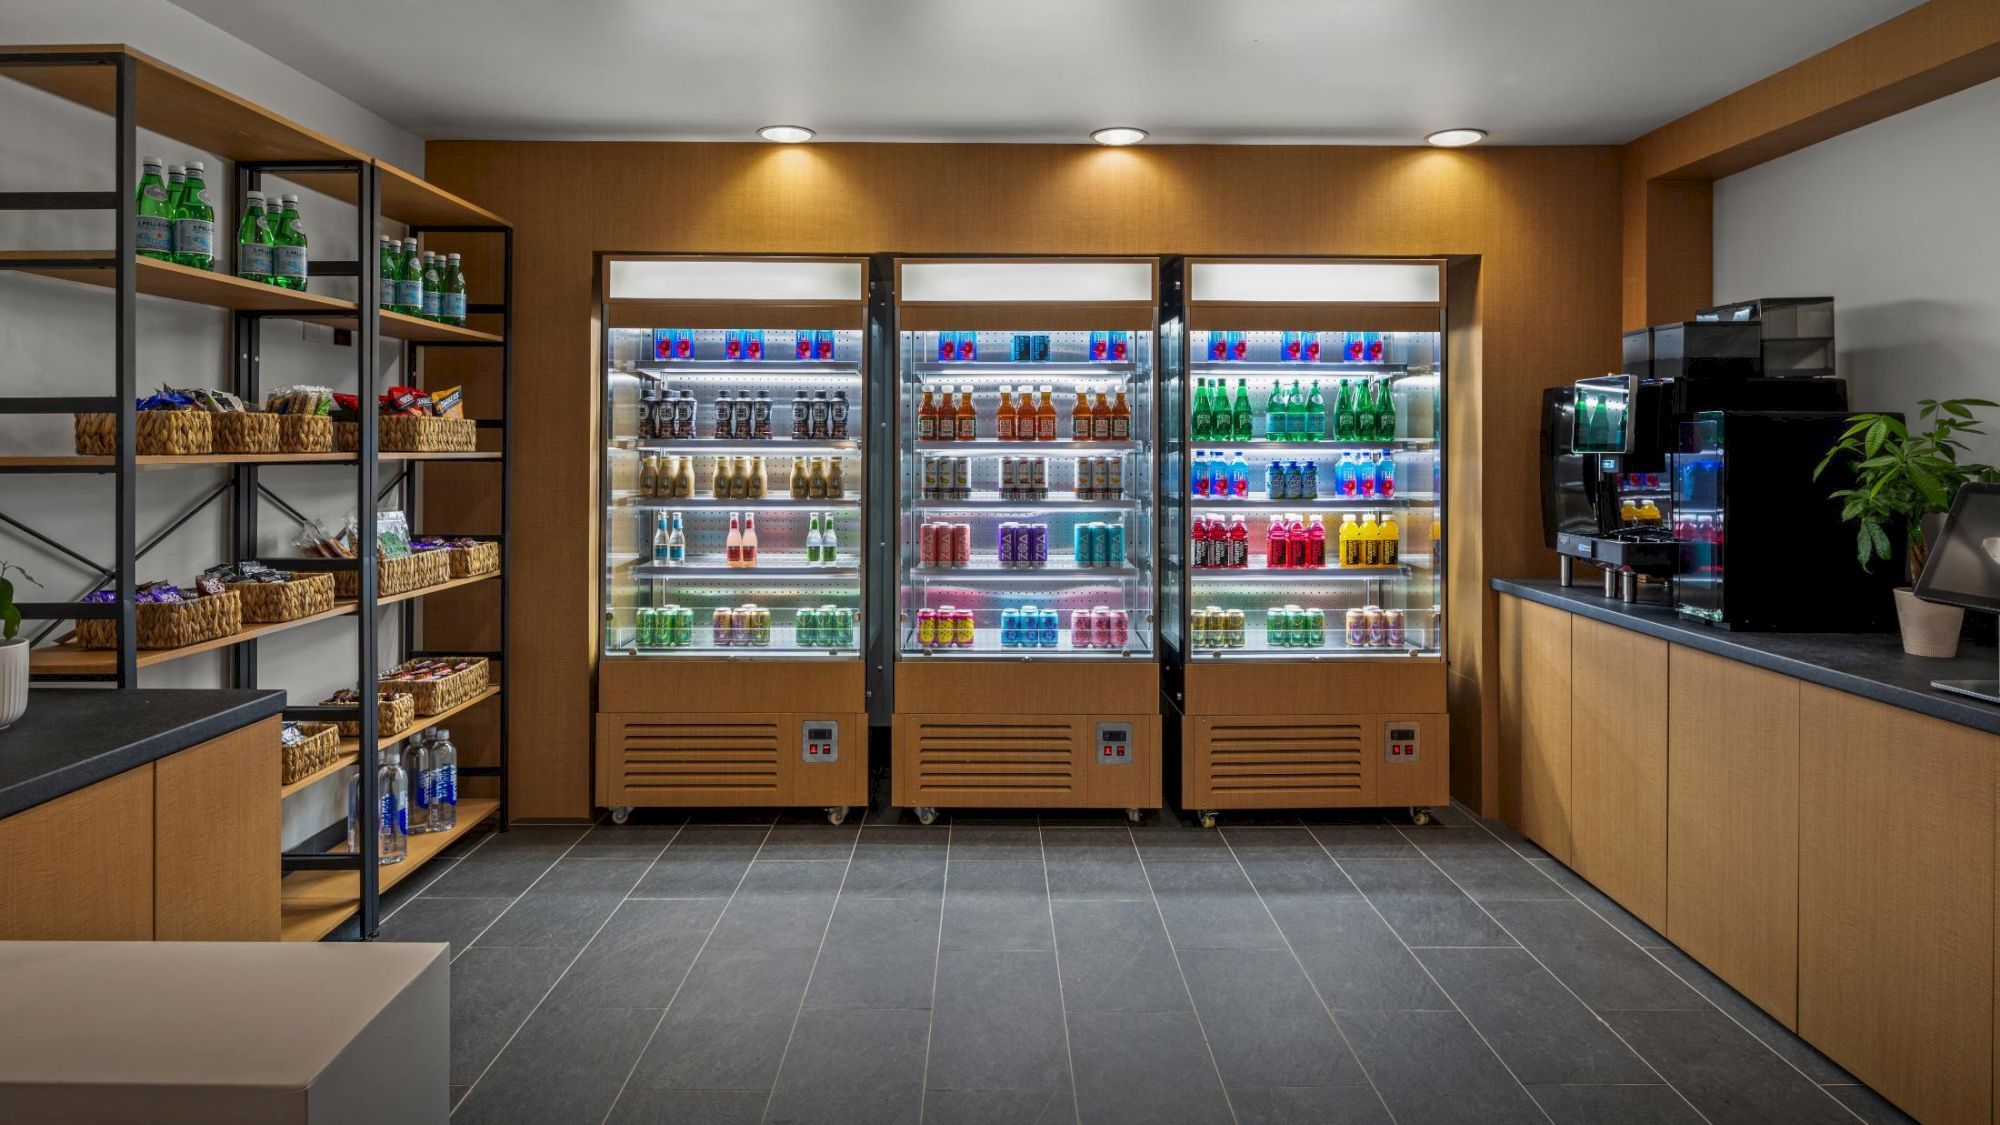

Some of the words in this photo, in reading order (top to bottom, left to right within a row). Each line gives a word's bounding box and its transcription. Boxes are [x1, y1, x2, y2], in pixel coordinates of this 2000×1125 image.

[1002, 534, 1012, 560] ZOA
[1018, 534, 1028, 560] ZOA
[1036, 534, 1046, 560] ZOA
